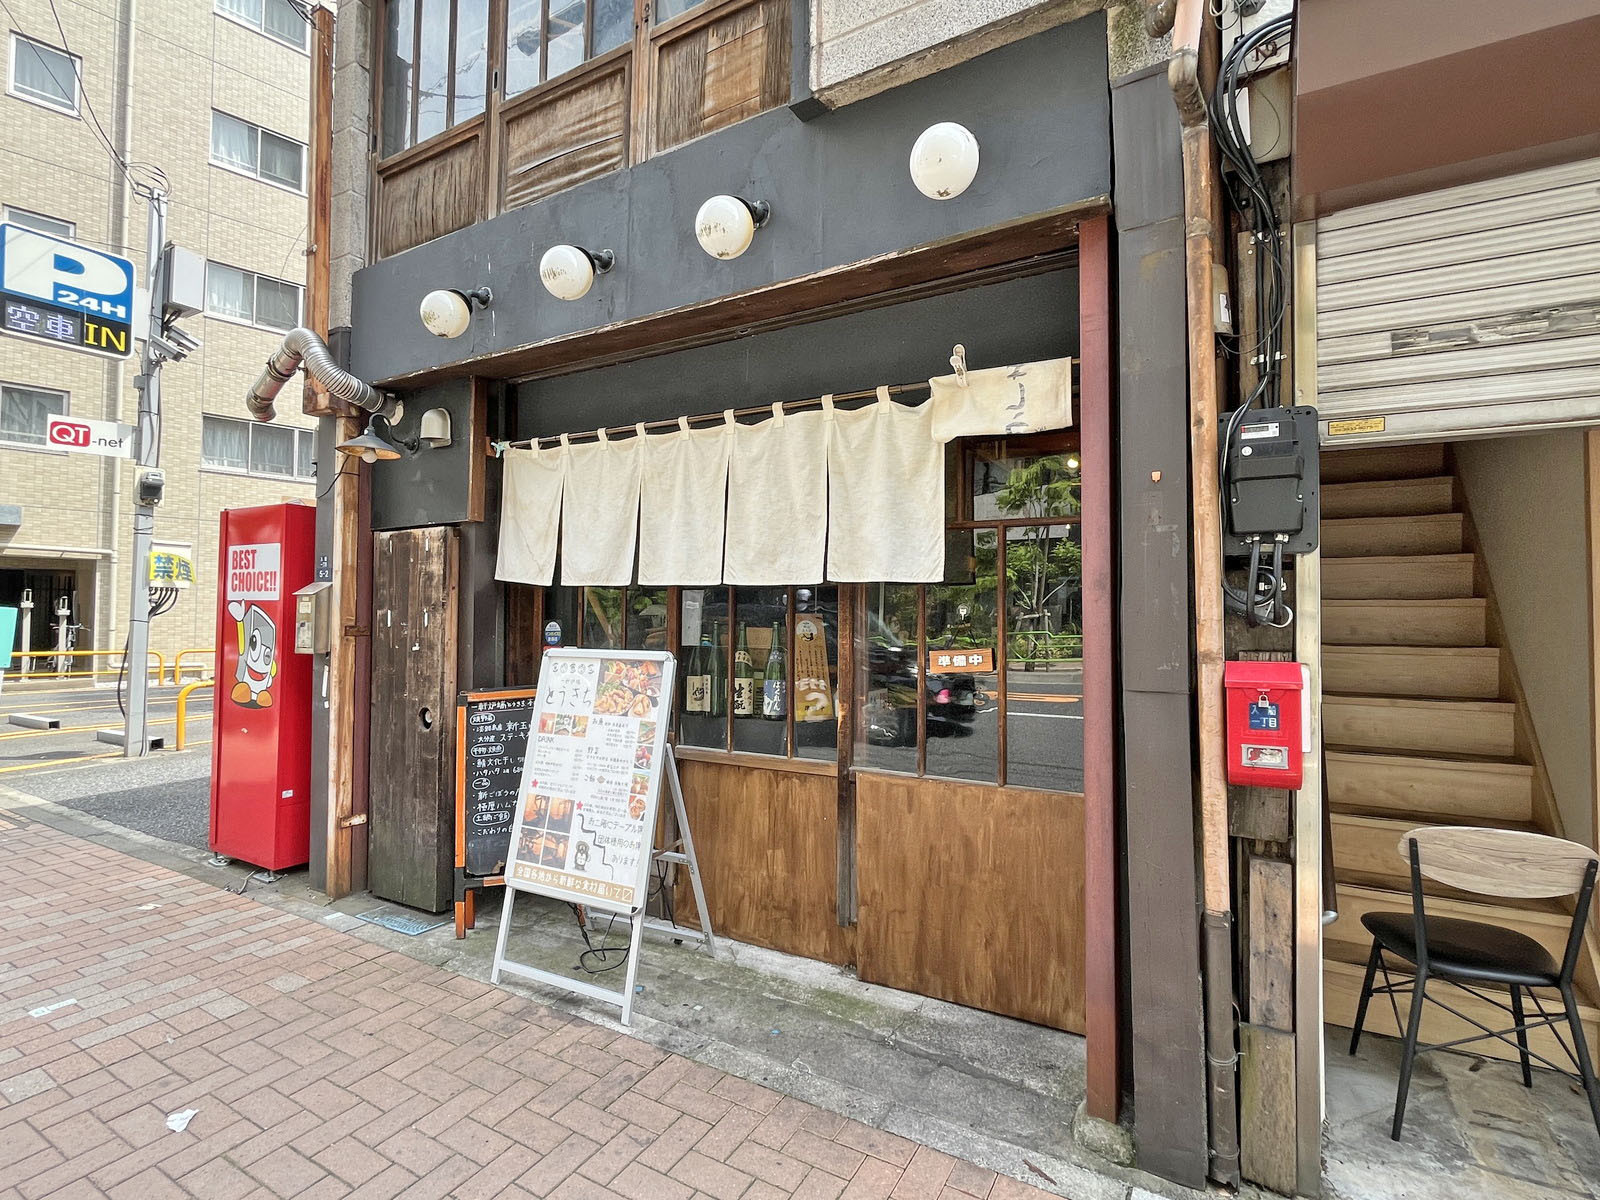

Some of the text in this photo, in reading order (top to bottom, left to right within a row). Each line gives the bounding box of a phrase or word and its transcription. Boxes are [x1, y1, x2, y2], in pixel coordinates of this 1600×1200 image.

[4, 226, 128, 301] P
[57, 290, 126, 318] 24H
[8, 304, 126, 352] 空車 IN
[153, 554, 194, 582] 禁煙
[231, 549, 257, 570] BEST
[230, 571, 277, 593] CHOICE!!
[319, 570, 329, 578] 5-2
[937, 653, 983, 667] 準備中
[505, 720, 531, 731] 新玉
[1251, 717, 1277, 728] 一丁目
